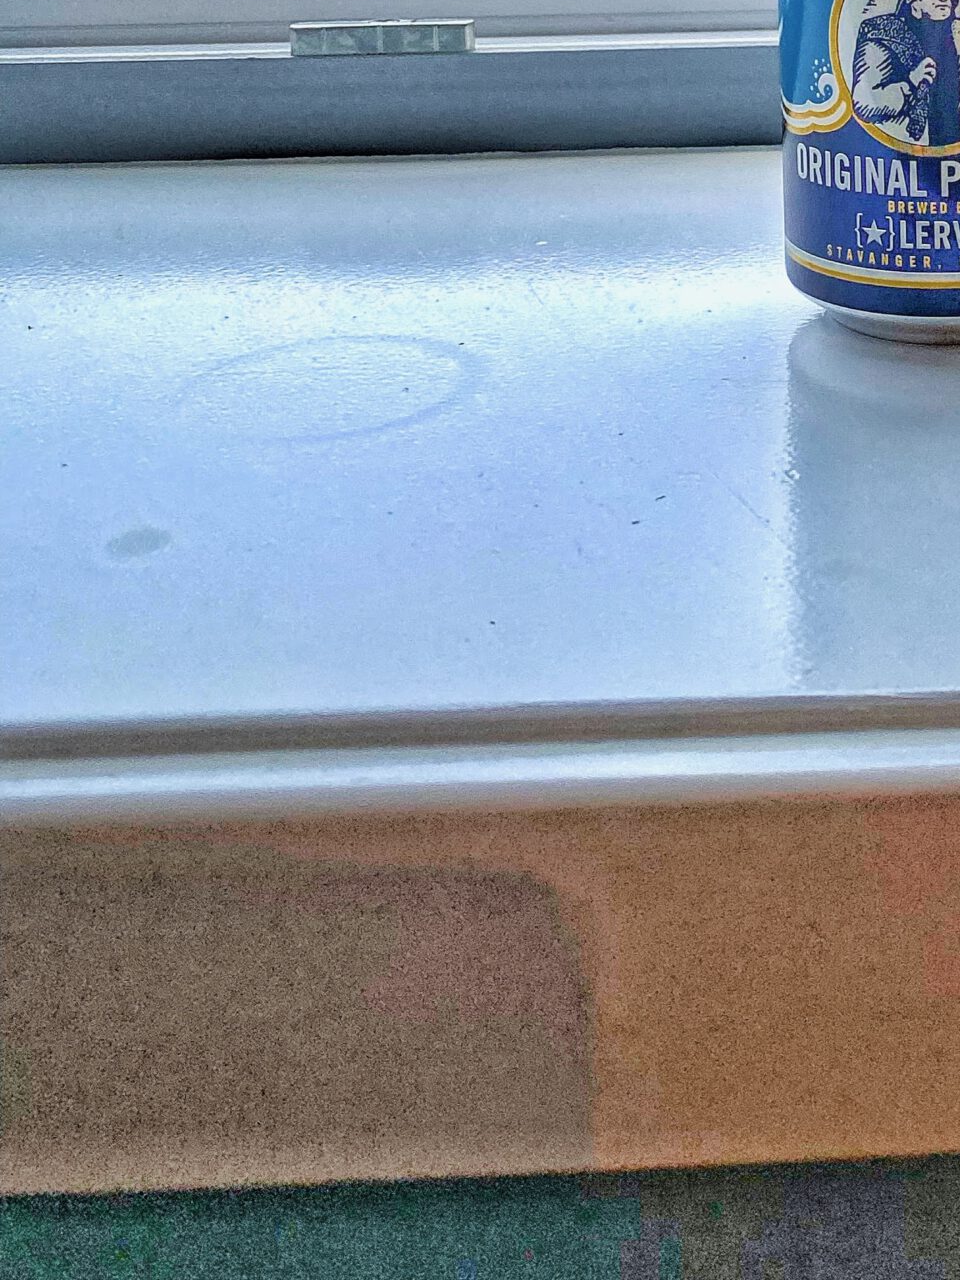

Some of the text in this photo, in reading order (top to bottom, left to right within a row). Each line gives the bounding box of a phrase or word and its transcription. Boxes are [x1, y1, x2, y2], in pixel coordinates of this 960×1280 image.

[796, 142, 928, 198] ORIGINAL
[887, 200, 948, 214] BREWED
[826, 244, 943, 269] STAVANGER,
